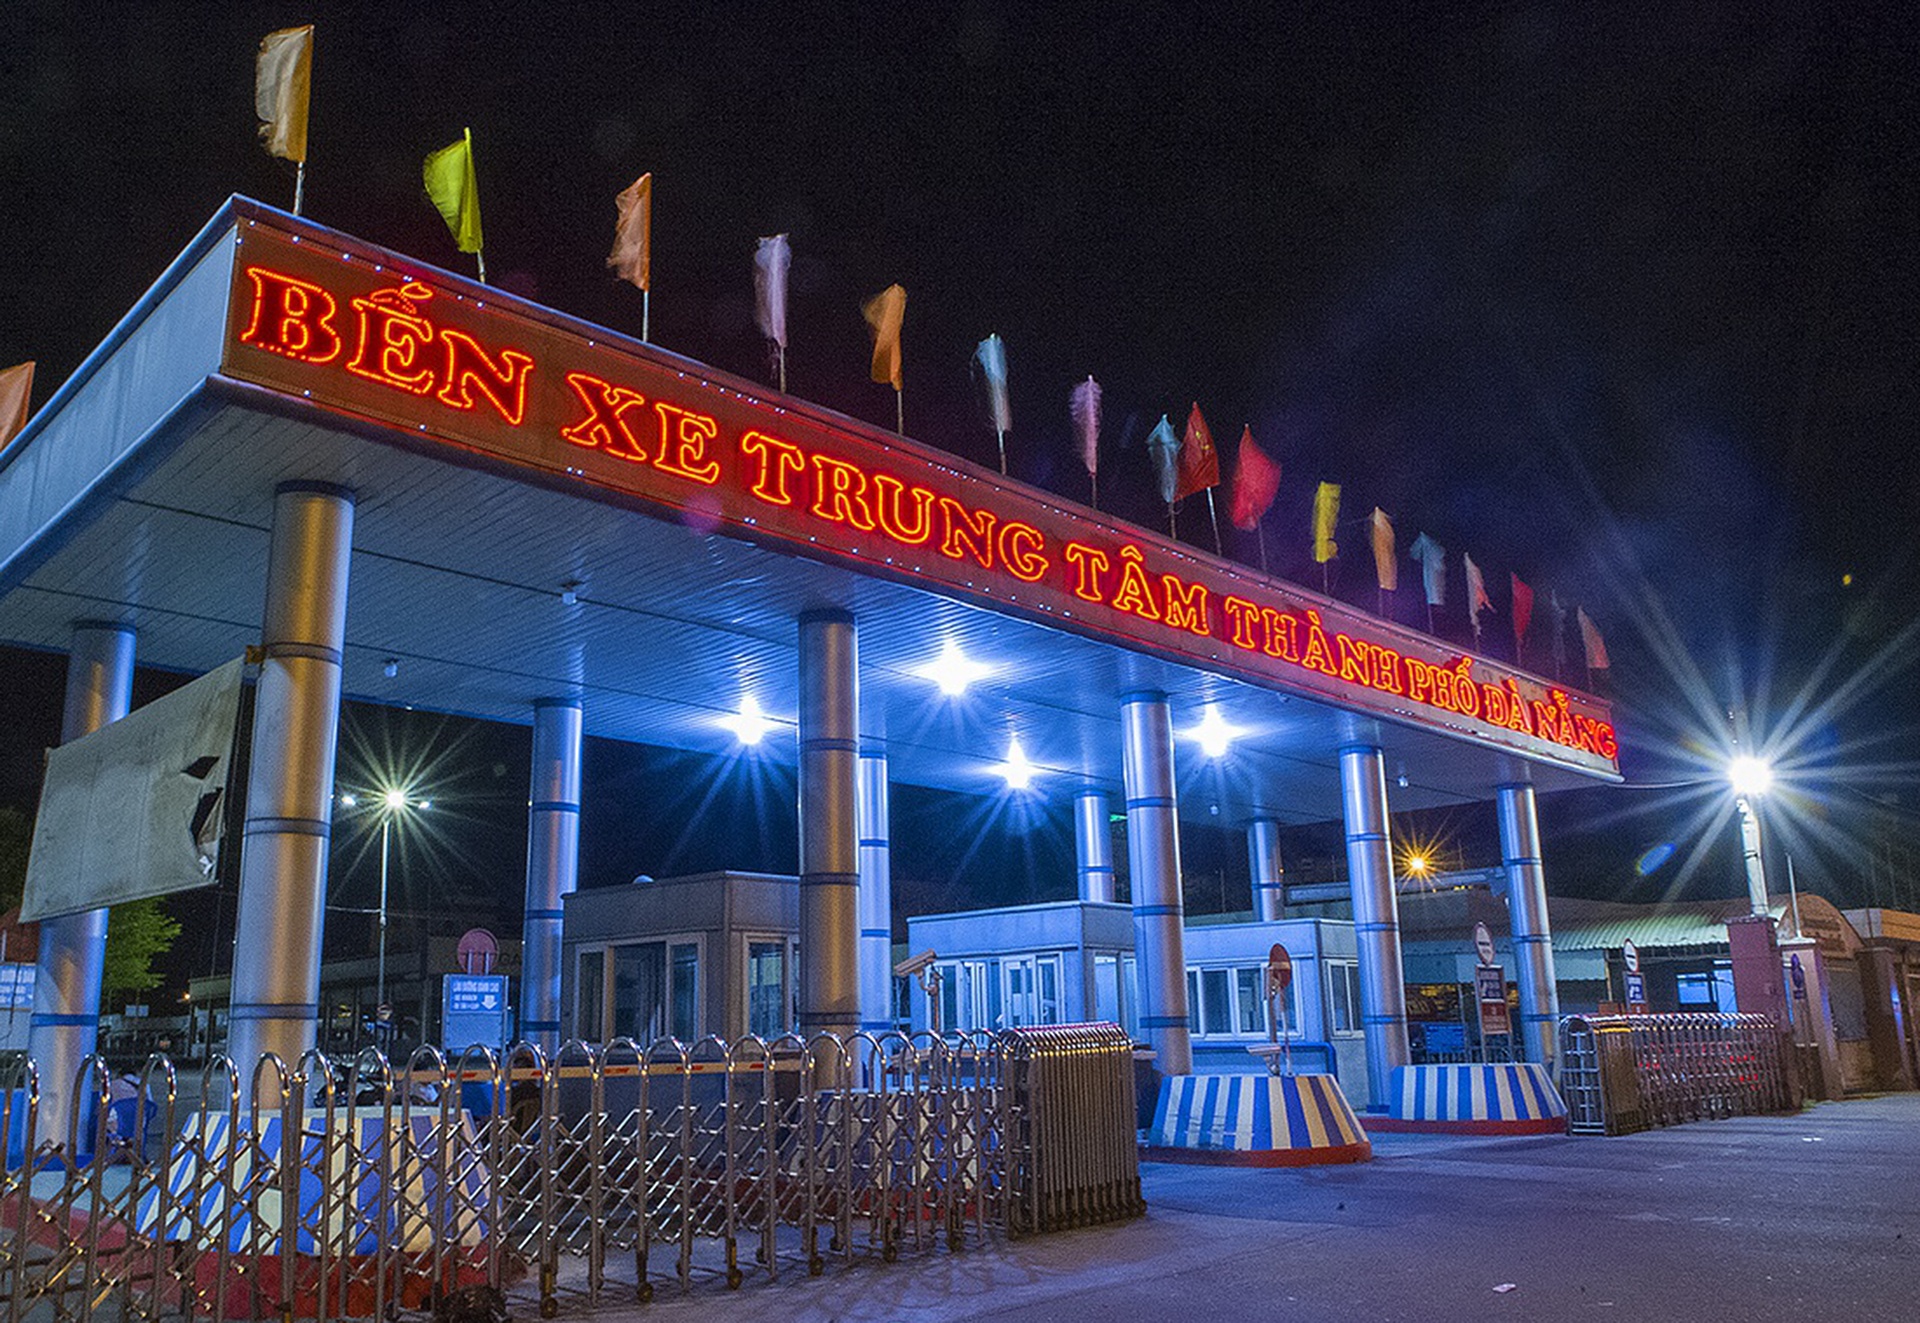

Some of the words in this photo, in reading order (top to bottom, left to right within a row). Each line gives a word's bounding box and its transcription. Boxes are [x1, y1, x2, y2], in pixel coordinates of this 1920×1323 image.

[240, 266, 534, 425] BẾN
[562, 372, 720, 484] XE
[742, 431, 1049, 581] TRUNG
[1066, 543, 1210, 636] TÂM
[1225, 596, 1403, 694] THÀNH
[1405, 656, 1481, 717] PHỐ
[1483, 677, 1533, 735] ĐÀ
[1534, 688, 1618, 760] NẴNG
